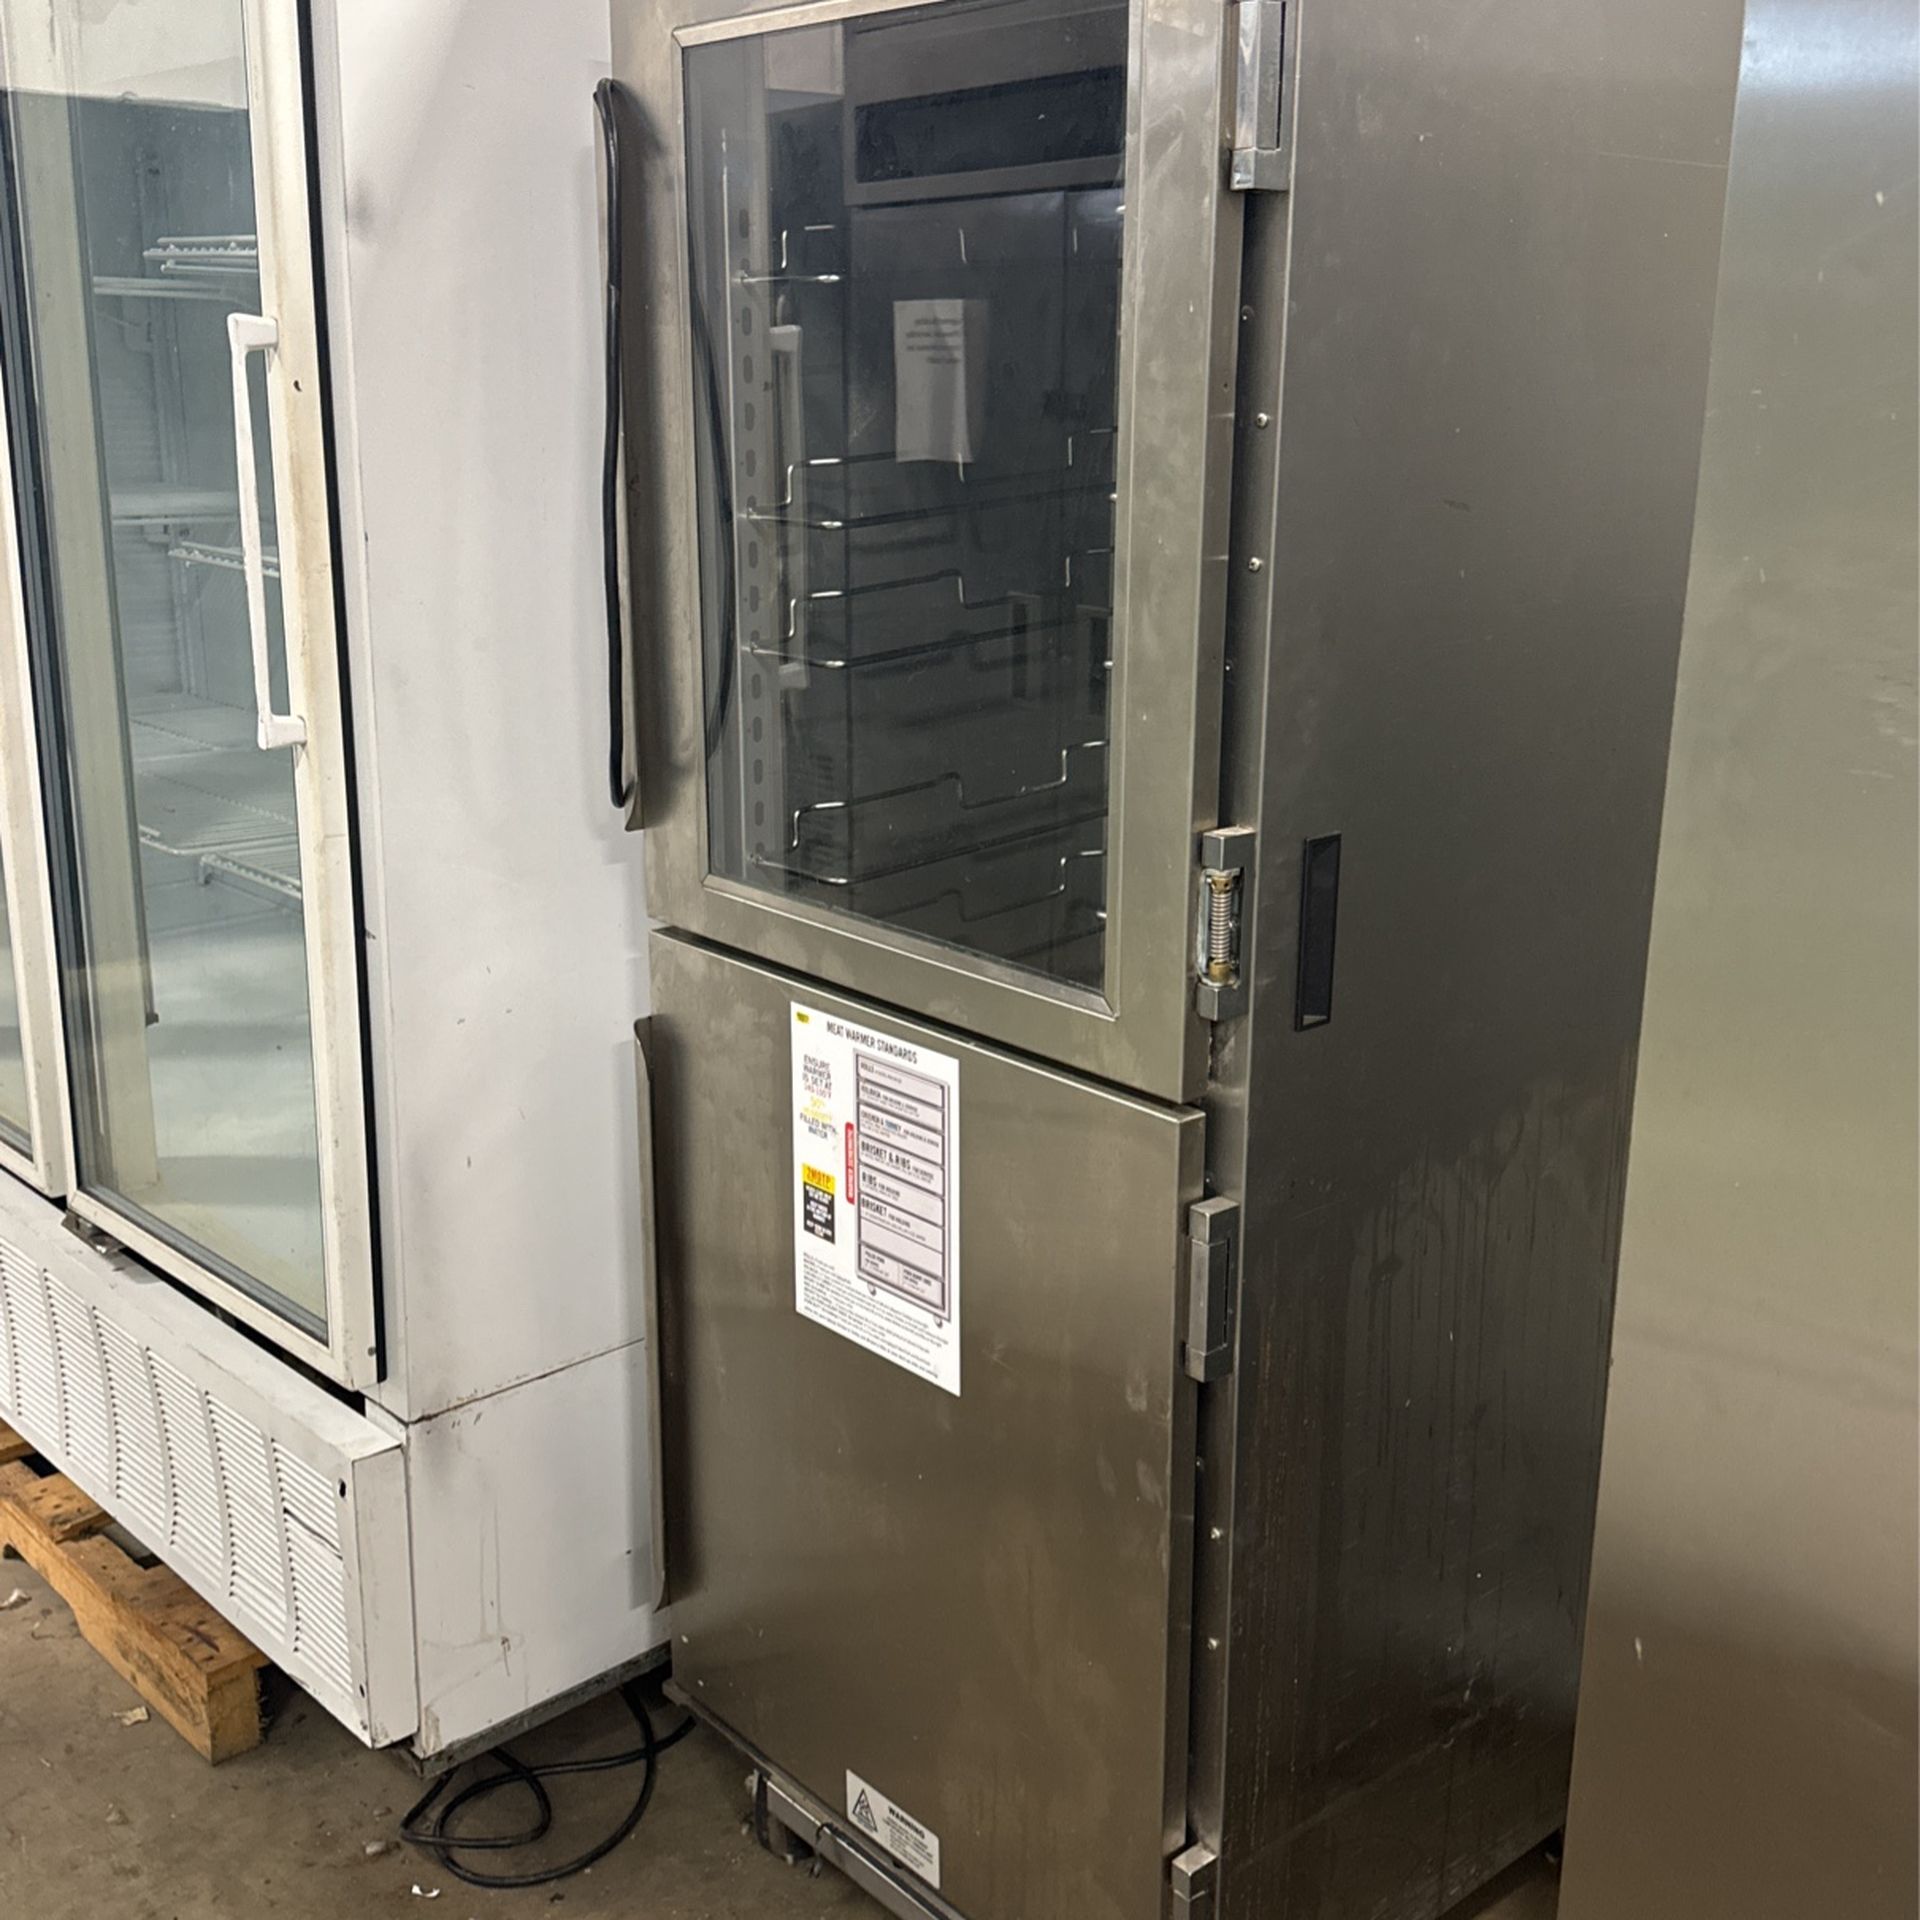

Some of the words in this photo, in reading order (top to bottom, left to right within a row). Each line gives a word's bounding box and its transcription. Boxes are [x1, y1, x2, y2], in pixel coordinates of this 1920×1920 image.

[827, 1021, 844, 1037] MEAT
[846, 1027, 875, 1048] WARMER
[877, 1039, 917, 1064] STANDARDS
[861, 1141, 887, 1157] BRISKET
[888, 1151, 894, 1163] &
[895, 1153, 910, 1170] RIBS
[862, 1172, 877, 1186] RIBS
[861, 1198, 887, 1217] BRISKET
[888, 1806, 925, 1839] WARNING
